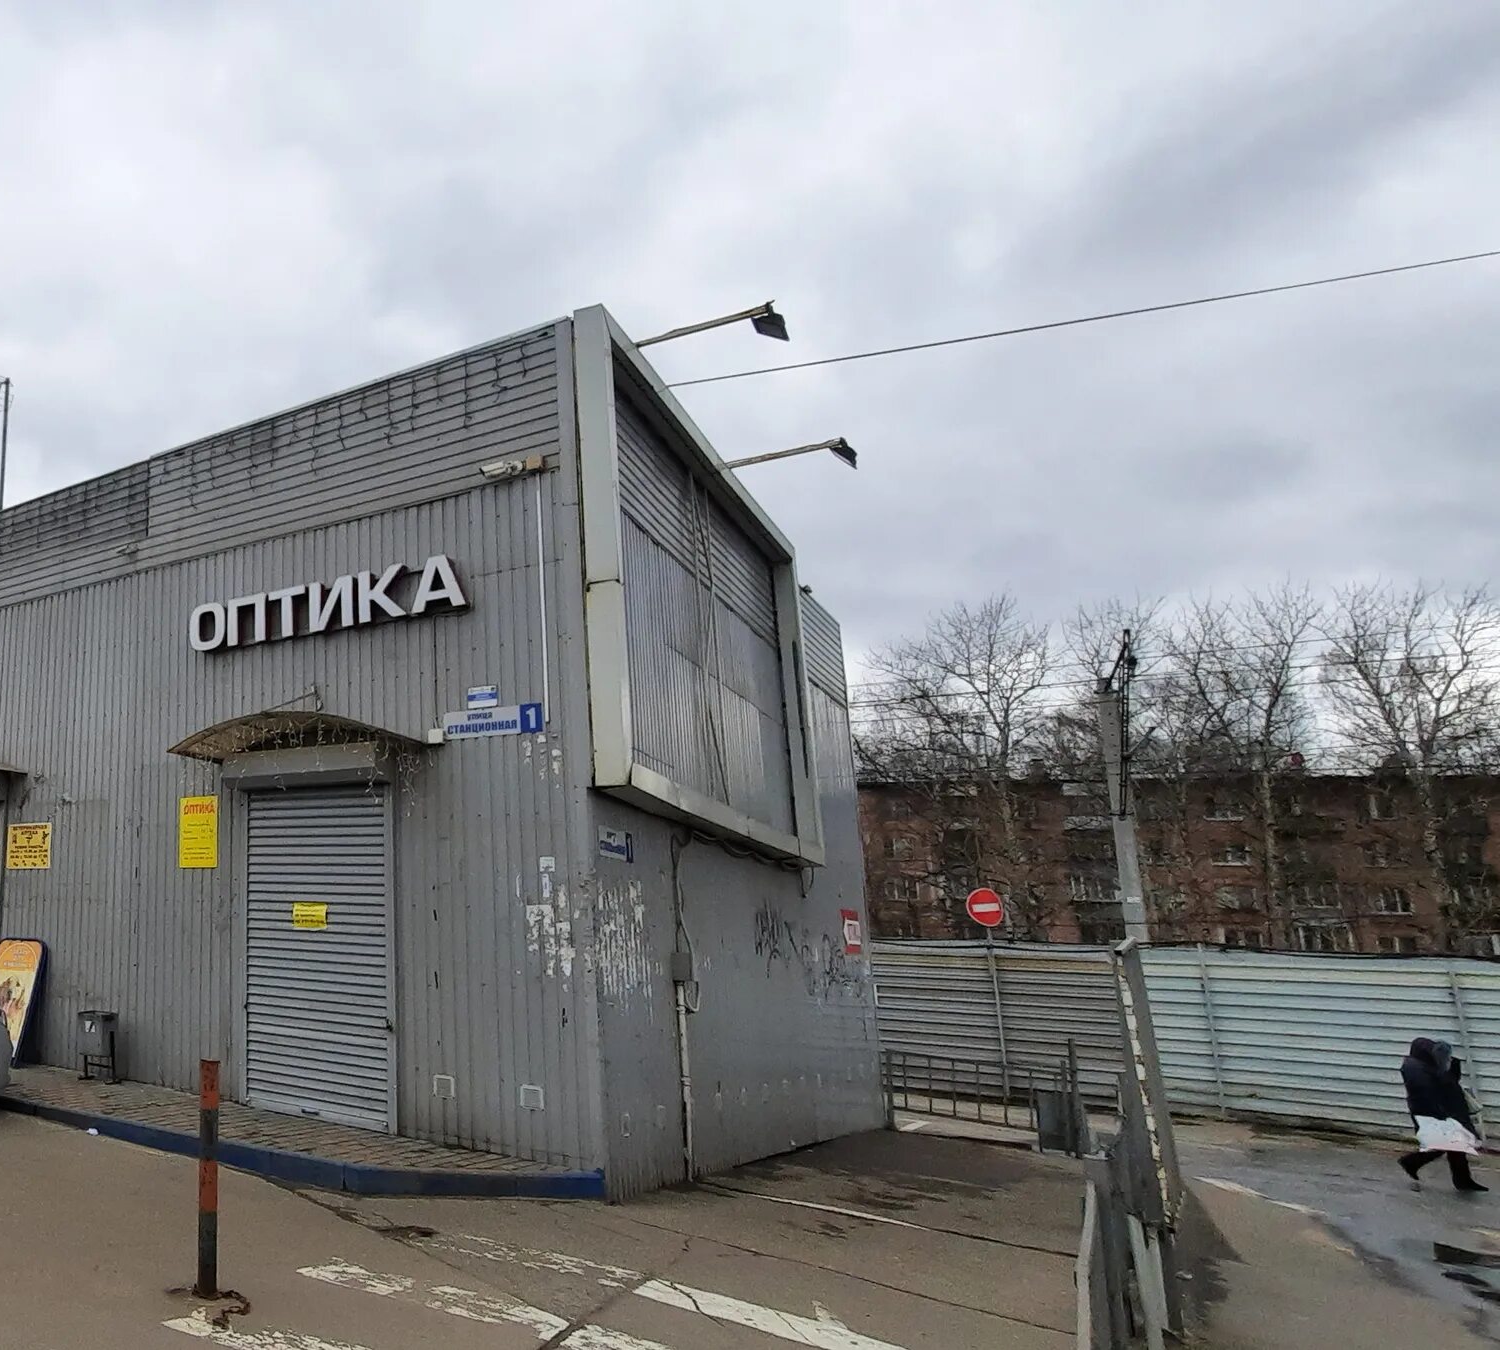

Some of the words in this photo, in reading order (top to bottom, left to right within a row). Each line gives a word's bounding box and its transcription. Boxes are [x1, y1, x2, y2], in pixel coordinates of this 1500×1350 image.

[188, 554, 467, 652] ОПТИКА
[447, 719, 518, 735] СТАНЦИОННАЯ
[525, 706, 537, 729] 1
[467, 712, 492, 721] улица
[183, 803, 215, 816] ОПТИКА
